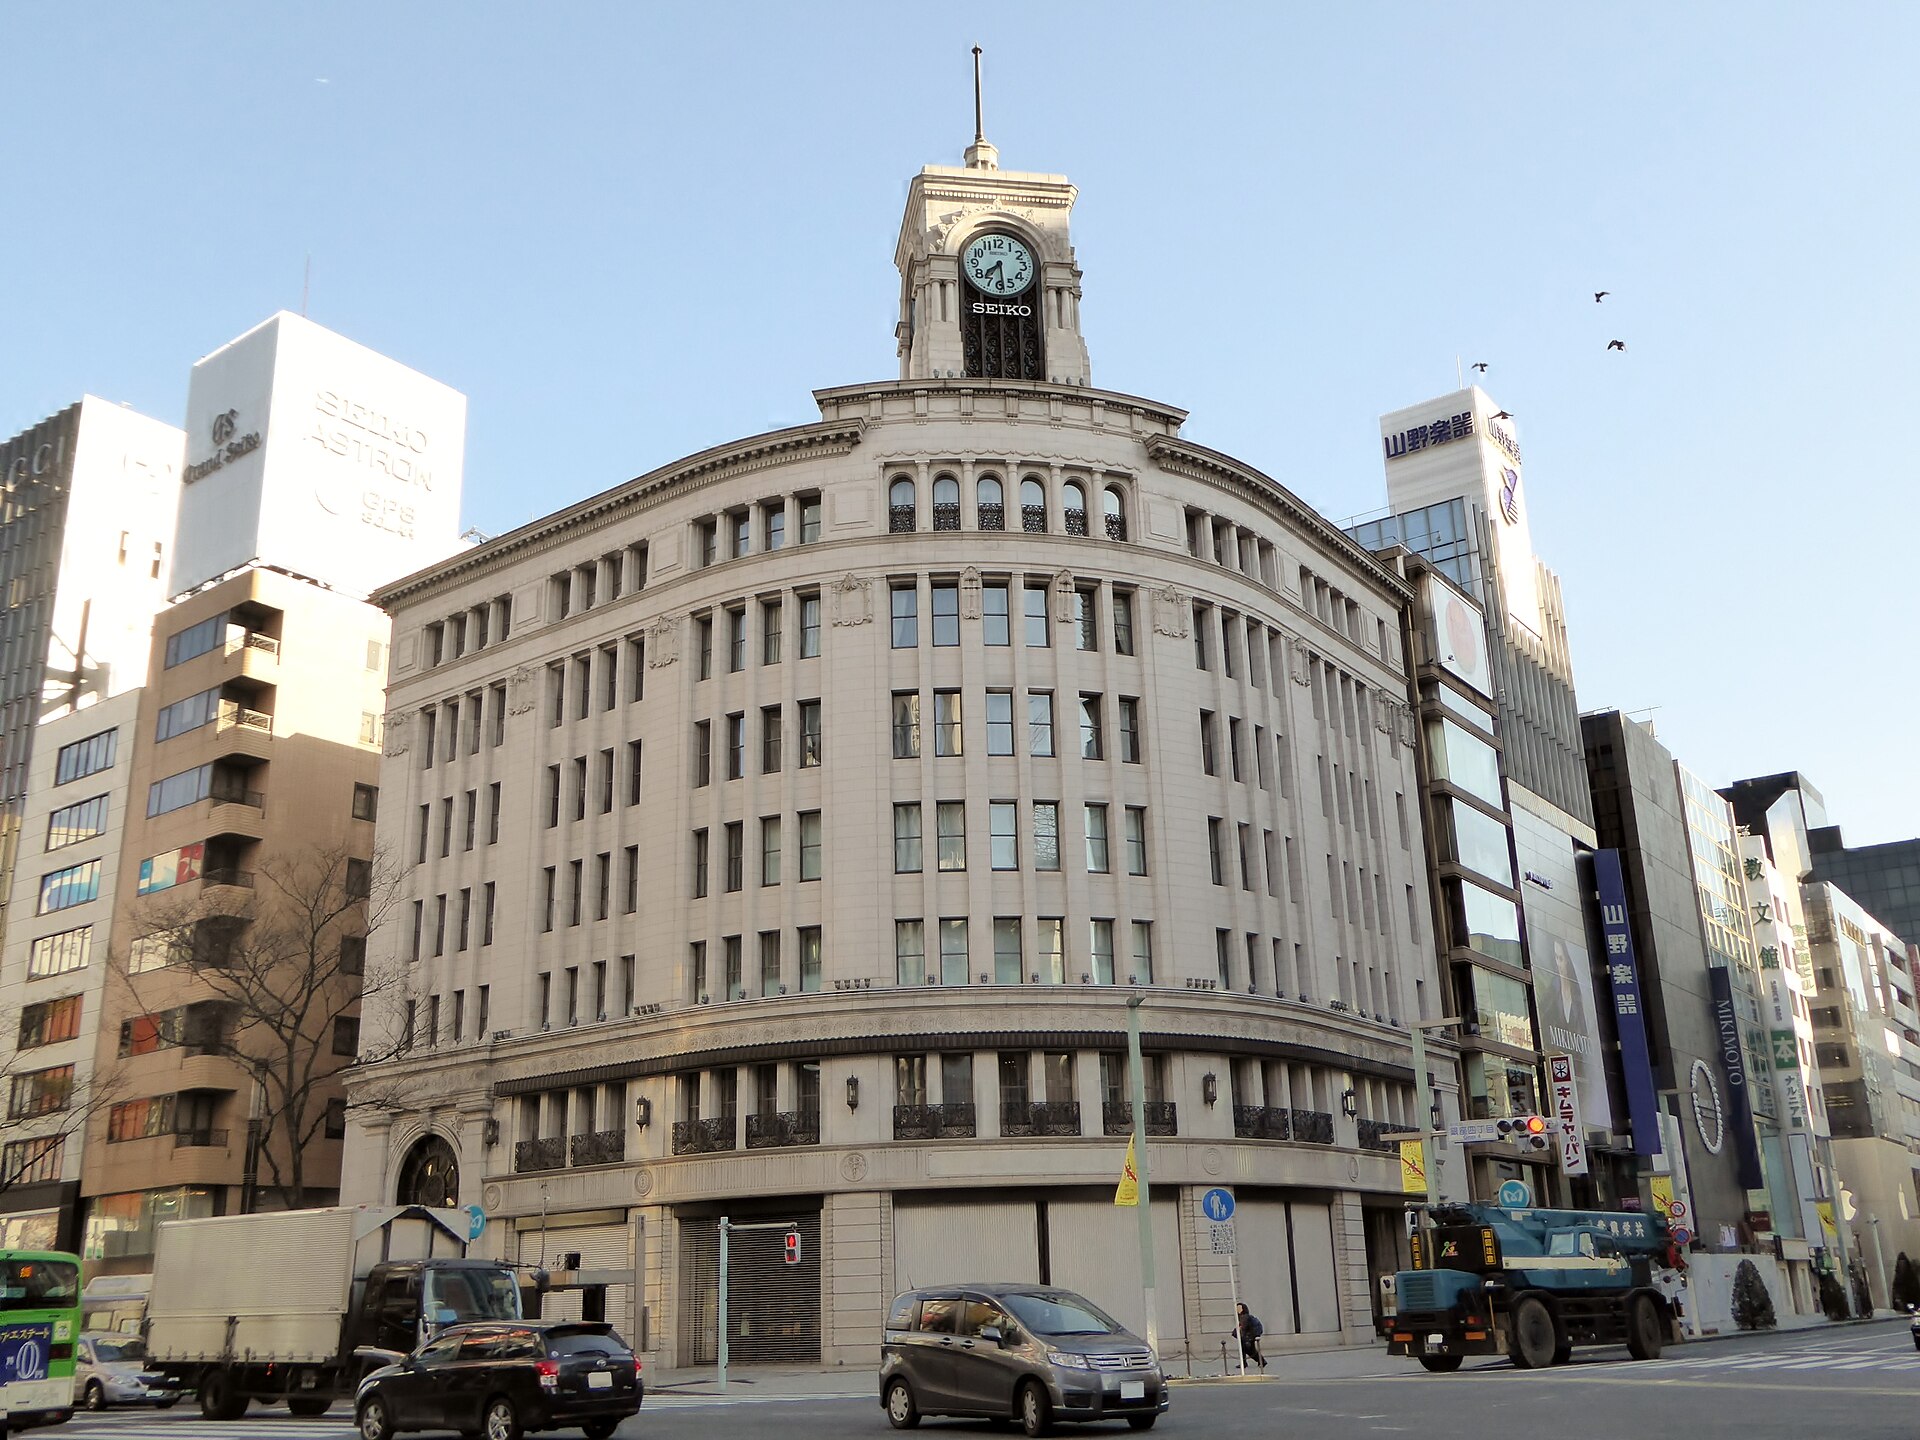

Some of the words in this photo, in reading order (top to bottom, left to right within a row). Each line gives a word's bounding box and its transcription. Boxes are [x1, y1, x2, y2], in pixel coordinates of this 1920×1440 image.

[993, 238, 1004, 249] 12
[974, 247, 983, 258] 10
[1015, 250, 1023, 261] 2
[971, 258, 979, 268] 9
[1019, 261, 1028, 272] 3
[975, 269, 983, 279] 8
[1015, 271, 1025, 281] 4
[1007, 279, 1015, 289] 5
[972, 302, 1031, 317] SEIKO
[1384, 411, 1475, 459] 山野楽器
[1744, 858, 1779, 969] 教文館
[1603, 904, 1637, 1014] 山野楽器
[1716, 999, 1743, 1086] MIKIMOTO
[1773, 1036, 1796, 1063] 本
[1450, 1124, 1494, 1136] 銀座四丁目
[1556, 1086, 1580, 1168] キムラヤのパン
